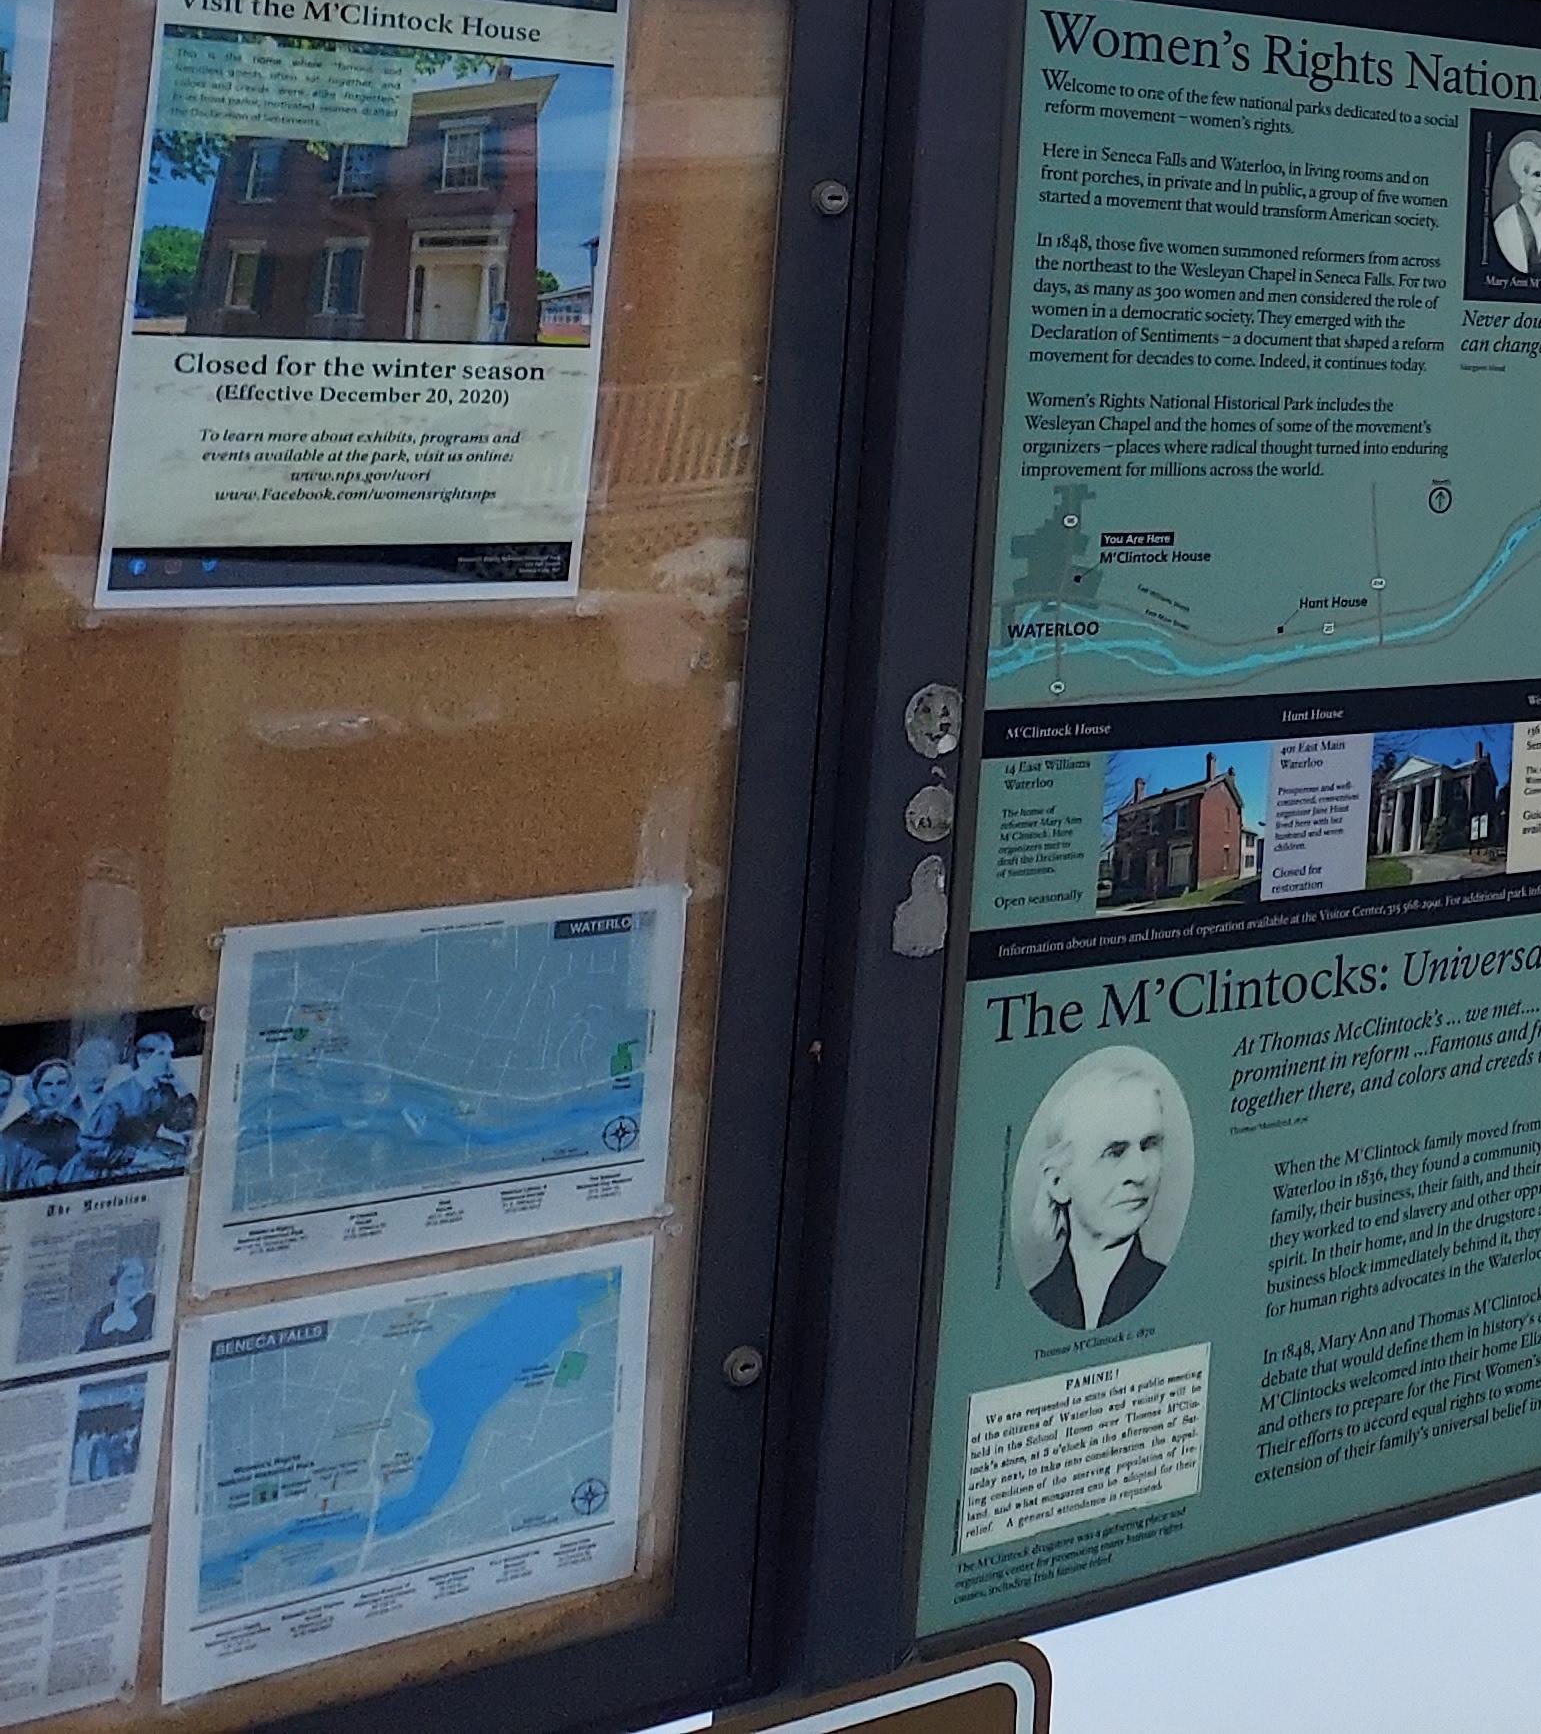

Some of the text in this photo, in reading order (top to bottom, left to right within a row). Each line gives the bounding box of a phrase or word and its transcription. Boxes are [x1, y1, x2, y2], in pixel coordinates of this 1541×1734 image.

[303, 1, 452, 32] M'Clintock
[462, 16, 540, 41] House
[1039, 10, 1249, 70] Women's
[1264, 35, 1392, 91] Rights
[1040, 68, 1458, 127] Welcome to one of the few national parks dedicated to a social
[1044, 99, 1095, 115] reform
[1099, 107, 1175, 123] movement
[1253, 118, 1294, 135] rights.
[1042, 142, 1428, 185] Here in Seneca Falls and Waterloo, in living rooms and on
[1461, 309, 1510, 327] Never
[1460, 339, 1489, 351] can
[174, 353, 544, 380] Closed for the winter season
[216, 384, 508, 406] (Effective December 20, 2020)
[201, 428, 520, 446] To learn more about exhibits, programs and
[201, 450, 250, 461] events
[254, 448, 324, 461] available
[327, 450, 342, 461] at
[345, 449, 368, 461] the
[370, 449, 409, 465] park,
[414, 450, 444, 462] visit
[447, 453, 463, 461] us
[290, 469, 431, 483] www.nps.gov/wori
[215, 487, 496, 502] www.Facebook.com/womensrightsnps
[1104, 534, 1170, 544] You Are Here
[1098, 550, 1211, 563] M'Clintock House
[1299, 596, 1368, 608] Hunt House
[1007, 621, 1100, 638] WATERLOO
[1282, 709, 1344, 721] Hunt House
[1006, 723, 1111, 738] M'Clintock House
[570, 915, 636, 935] WATERLO
[986, 992, 1083, 1041] The
[1097, 956, 1388, 1026] M'Clintocks:
[1230, 1087, 1304, 1116] together
[1307, 1080, 1355, 1100] there,
[1360, 1068, 1395, 1092] and
[1397, 1064, 1447, 1086] colors
[1450, 1054, 1483, 1077] and
[1485, 1047, 1534, 1071] creeds
[1274, 1159, 1315, 1175] When
[1319, 1153, 1340, 1169] the
[1344, 1138, 1420, 1164] M'Clintock
[1423, 1131, 1462, 1150] family
[1466, 1121, 1508, 1142] moved
[1511, 1119, 1541, 1134] from
[215, 1325, 322, 1355] SENECA FALLS
